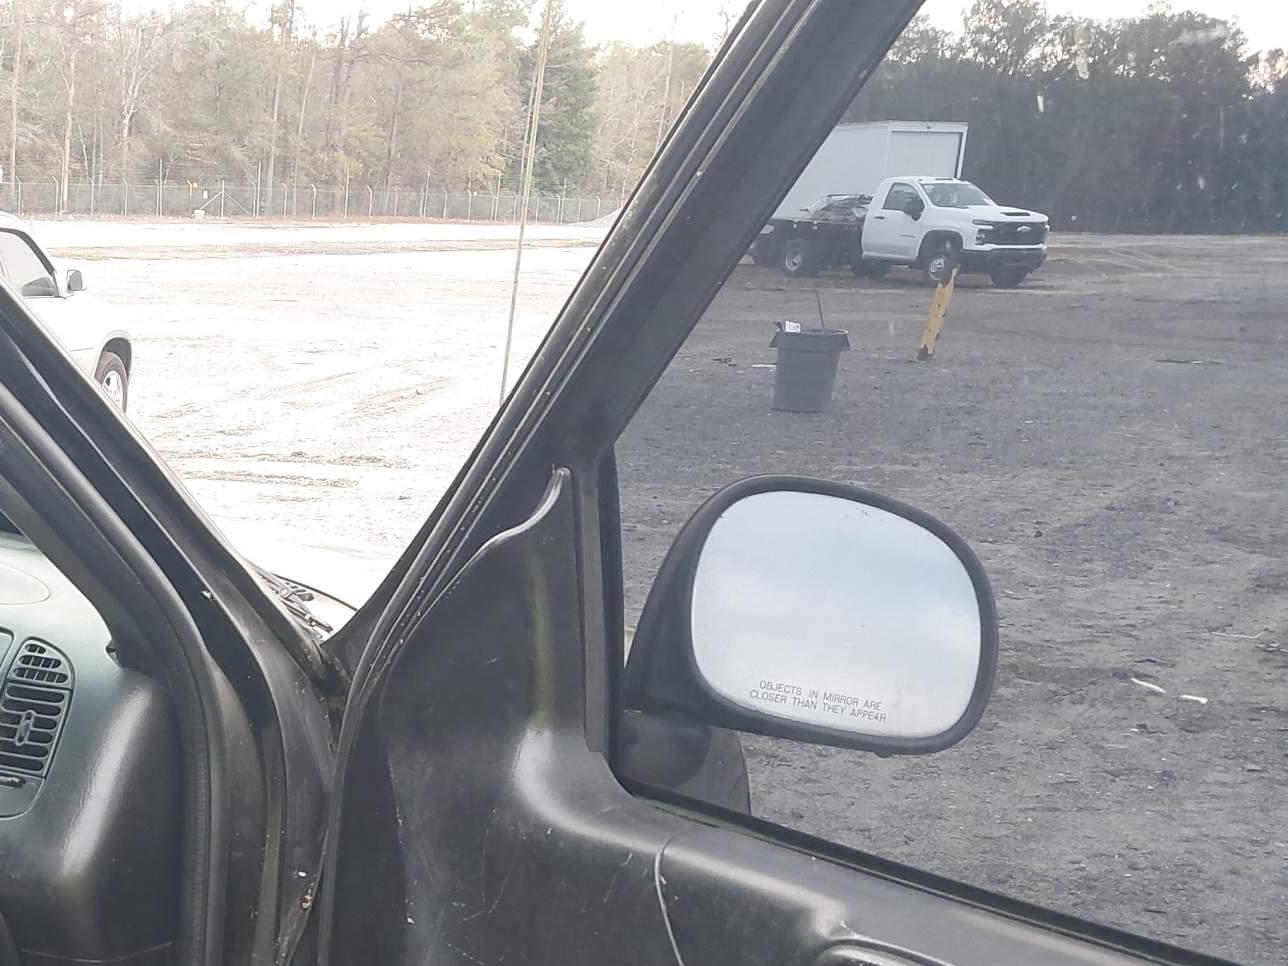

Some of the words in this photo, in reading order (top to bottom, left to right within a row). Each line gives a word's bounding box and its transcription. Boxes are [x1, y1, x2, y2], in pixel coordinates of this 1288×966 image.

[750, 689, 787, 705] CLOSER
[792, 696, 817, 710] THAN
[822, 702, 846, 716] THEY
[849, 708, 887, 723] APPEAR
[759, 679, 802, 696] OBJECTS
[809, 688, 819, 699] IN
[823, 691, 859, 706] MIRROR
[862, 699, 883, 711] ARE
